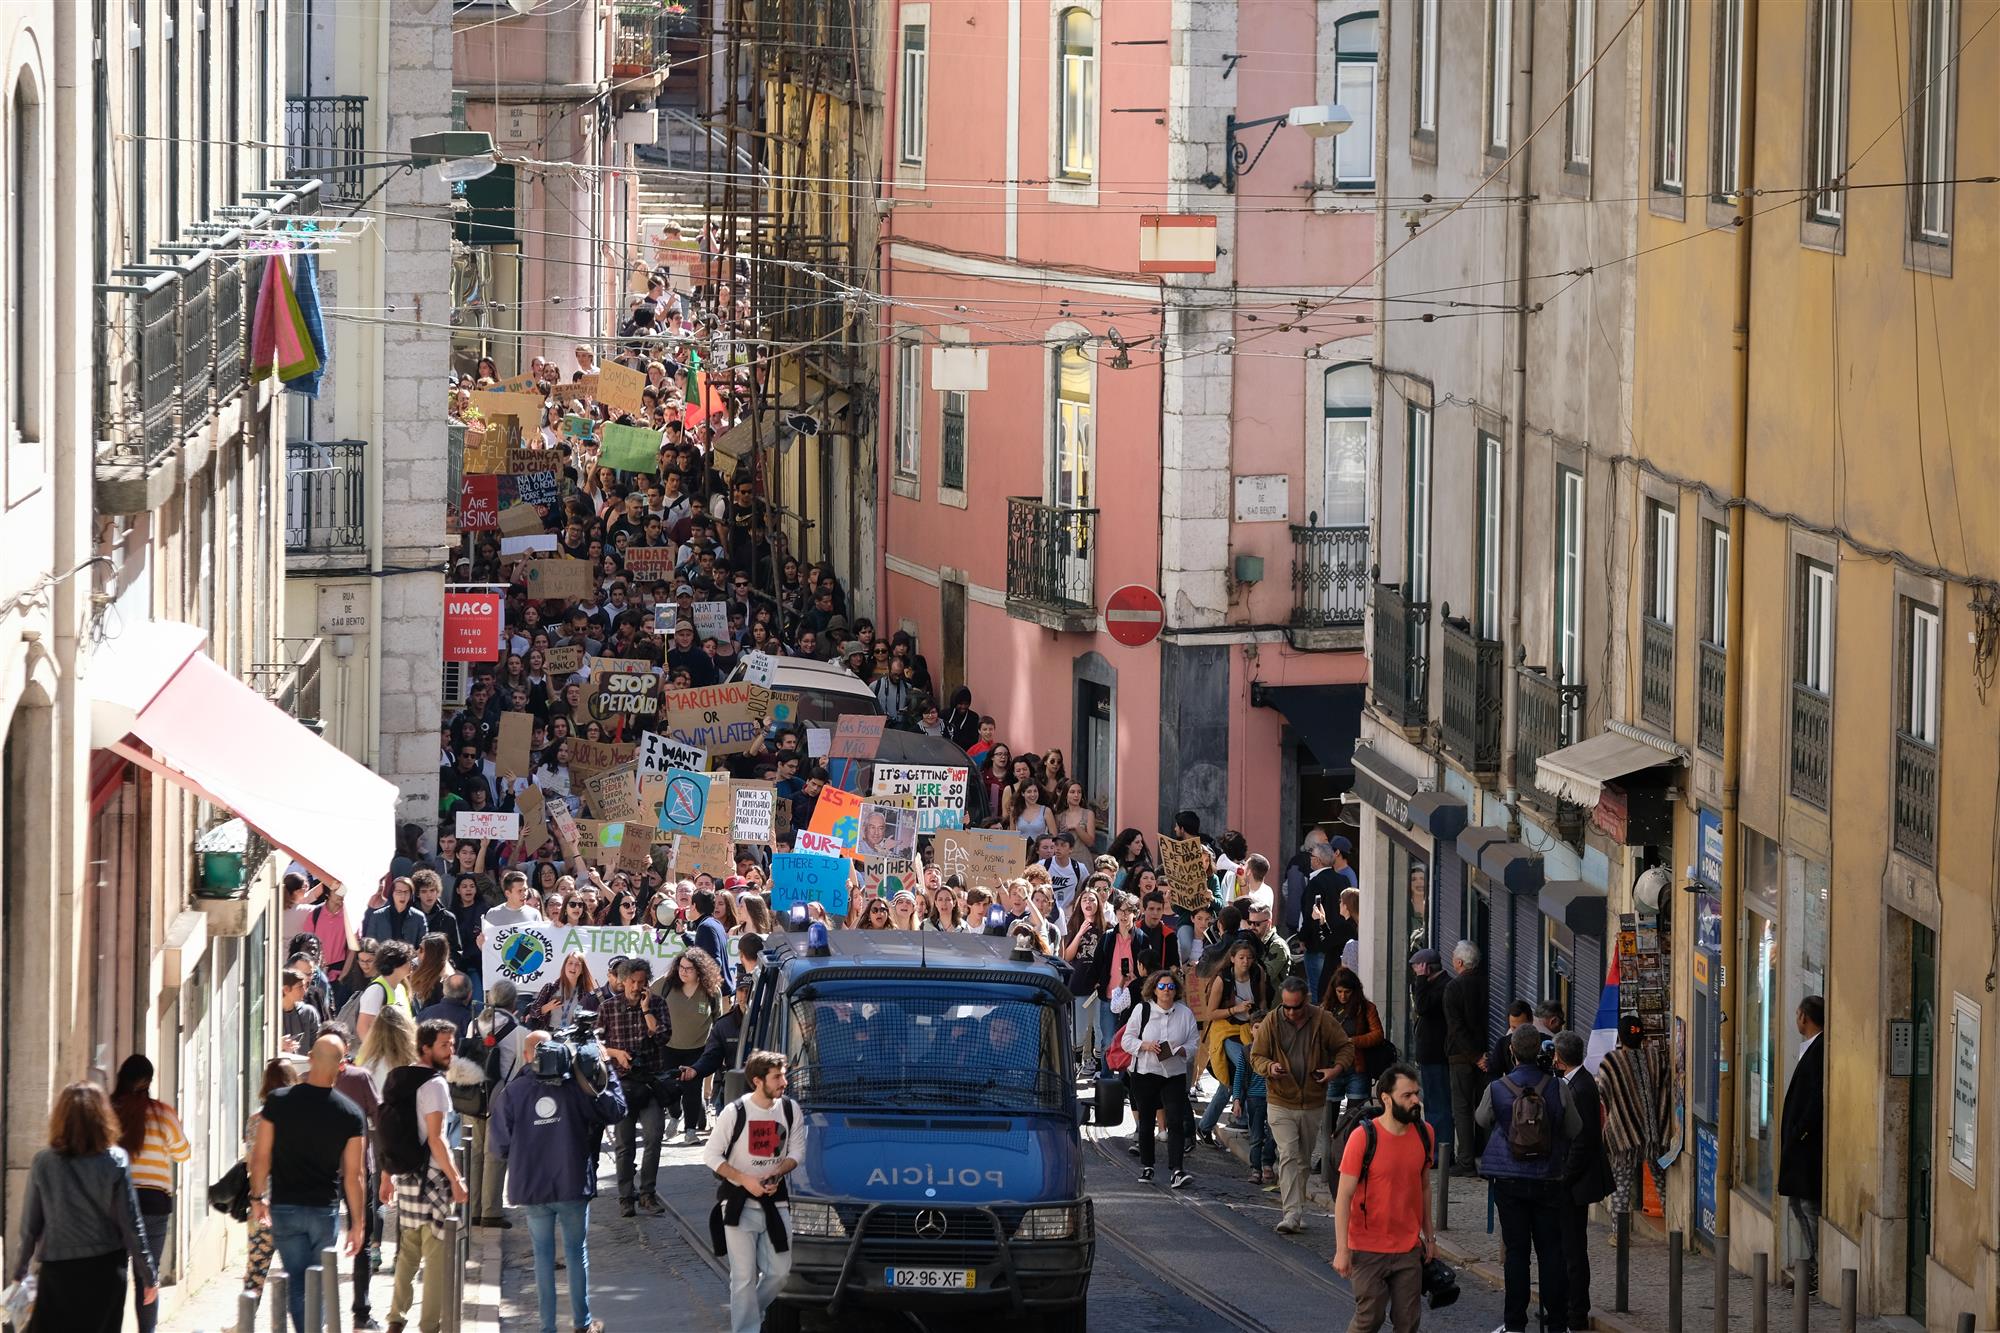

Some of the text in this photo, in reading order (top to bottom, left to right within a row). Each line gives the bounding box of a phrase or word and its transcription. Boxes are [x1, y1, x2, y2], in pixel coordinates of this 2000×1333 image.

[468, 497, 488, 509] ARE
[343, 592, 354, 600] RUA
[345, 605, 352, 613] DE
[448, 602, 493, 615] NACO
[694, 603, 713, 613] WHAT
[346, 617, 365, 625] BENTO
[460, 628, 481, 636] TALHO
[453, 647, 487, 655] IGUARIAS
[608, 674, 656, 694] STOP
[665, 684, 751, 712] MARCH NOW
[703, 711, 719, 723] OR
[672, 721, 757, 746] SWIM LATER
[647, 735, 702, 766] I WANT
[645, 756, 654, 769] A
[879, 768, 968, 782] IT'S GETTING HOT
[894, 783, 963, 795] IN HERE SO
[822, 787, 843, 806] IS
[944, 796, 963, 808] TO
[477, 814, 493, 822] WANT
[469, 827, 497, 837] PANIC
[980, 834, 993, 842] THE
[802, 832, 832, 853] OUR
[1171, 841, 1199, 854] TERRA
[777, 856, 839, 871] THERE IS
[985, 855, 1004, 863] RISING
[867, 861, 914, 875] MOTHER
[797, 874, 818, 884] NO
[1052, 876, 1070, 886] NIKE
[778, 887, 843, 907] PLANET B
[493, 926, 519, 951] GREVE
[562, 929, 584, 954] A
[587, 929, 655, 955] TERRA
[496, 964, 544, 985] PORTUGAL
